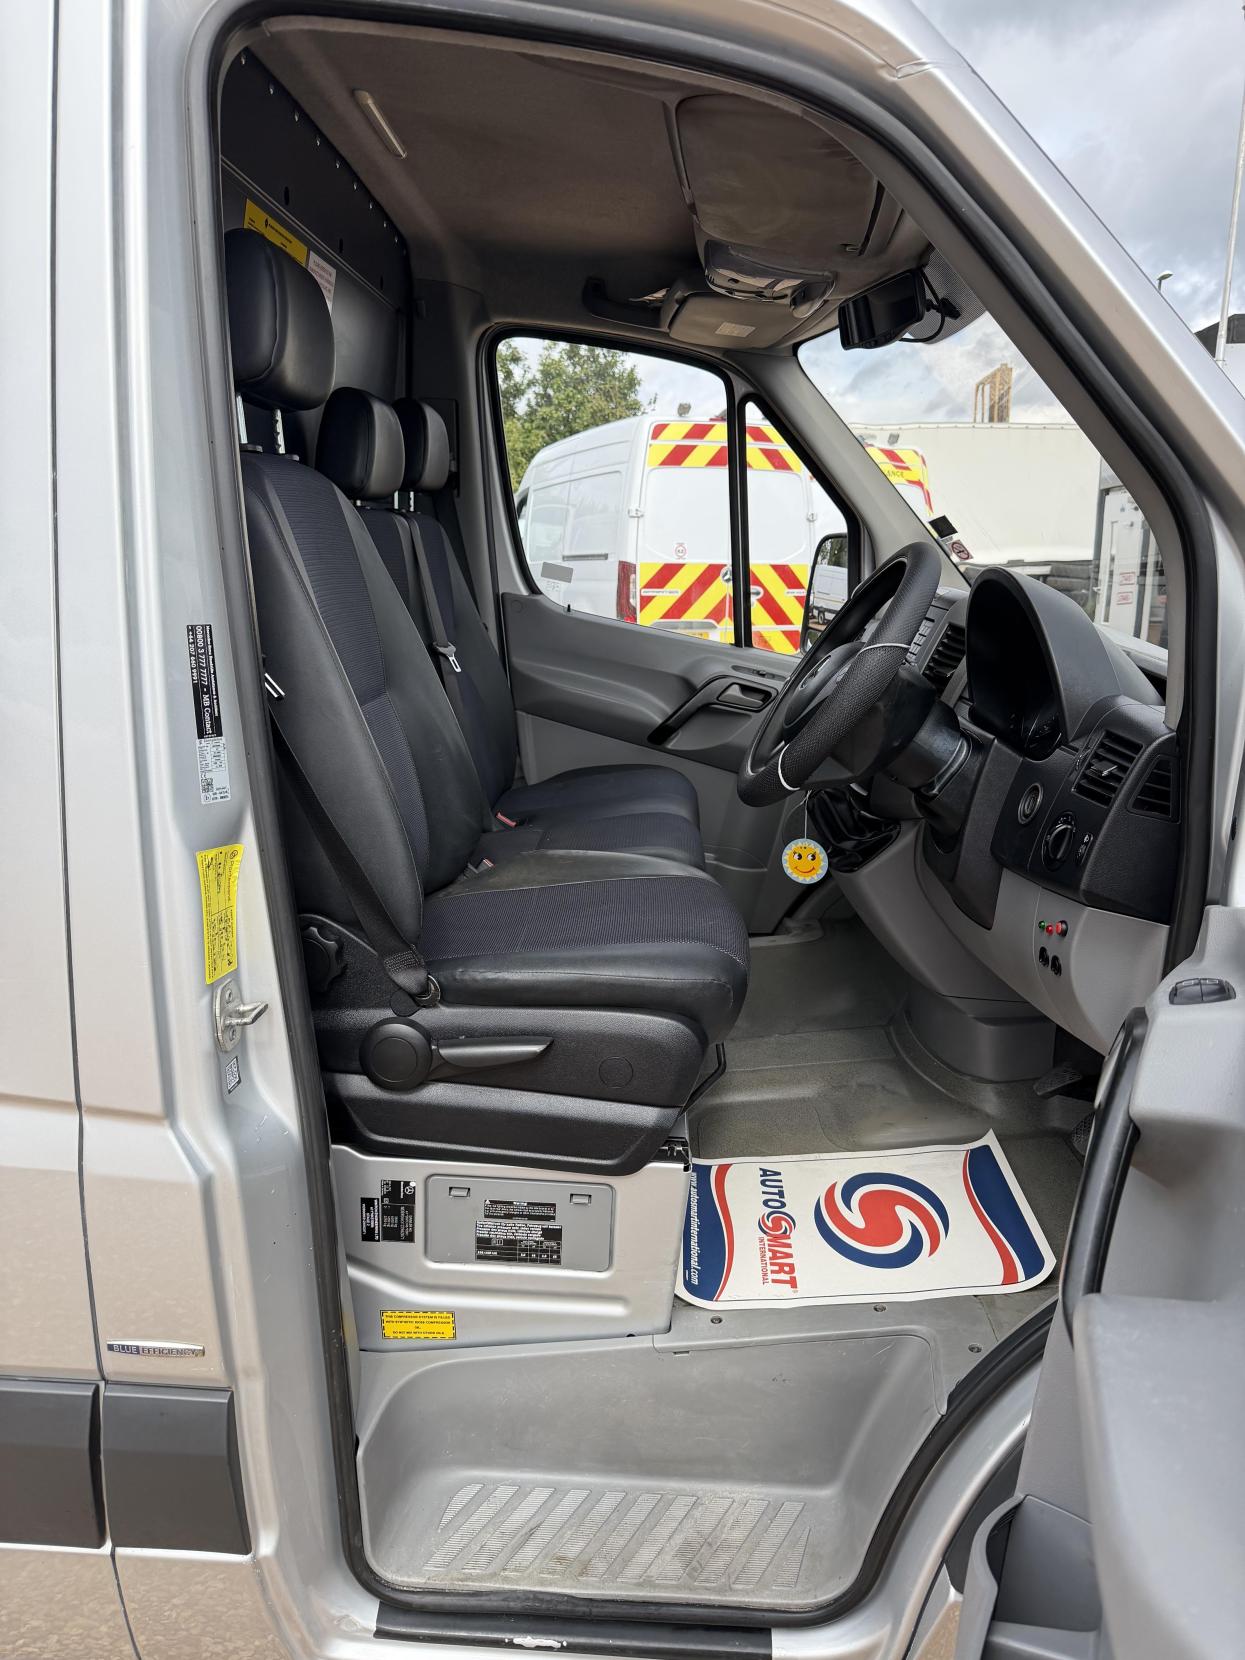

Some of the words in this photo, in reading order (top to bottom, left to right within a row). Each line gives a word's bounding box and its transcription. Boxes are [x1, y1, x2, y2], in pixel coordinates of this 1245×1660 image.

[196, 625, 204, 647] 00800
[200, 667, 208, 685] 7777
[203, 694, 210, 706] MB
[204, 707, 212, 734] Contact
[690, 1172, 701, 1285] www.autosmartinternational.com
[758, 1236, 769, 1286] INTERNATIONAL
[113, 1344, 137, 1354] BLUE
[142, 1346, 196, 1356] EFFICIENCY
